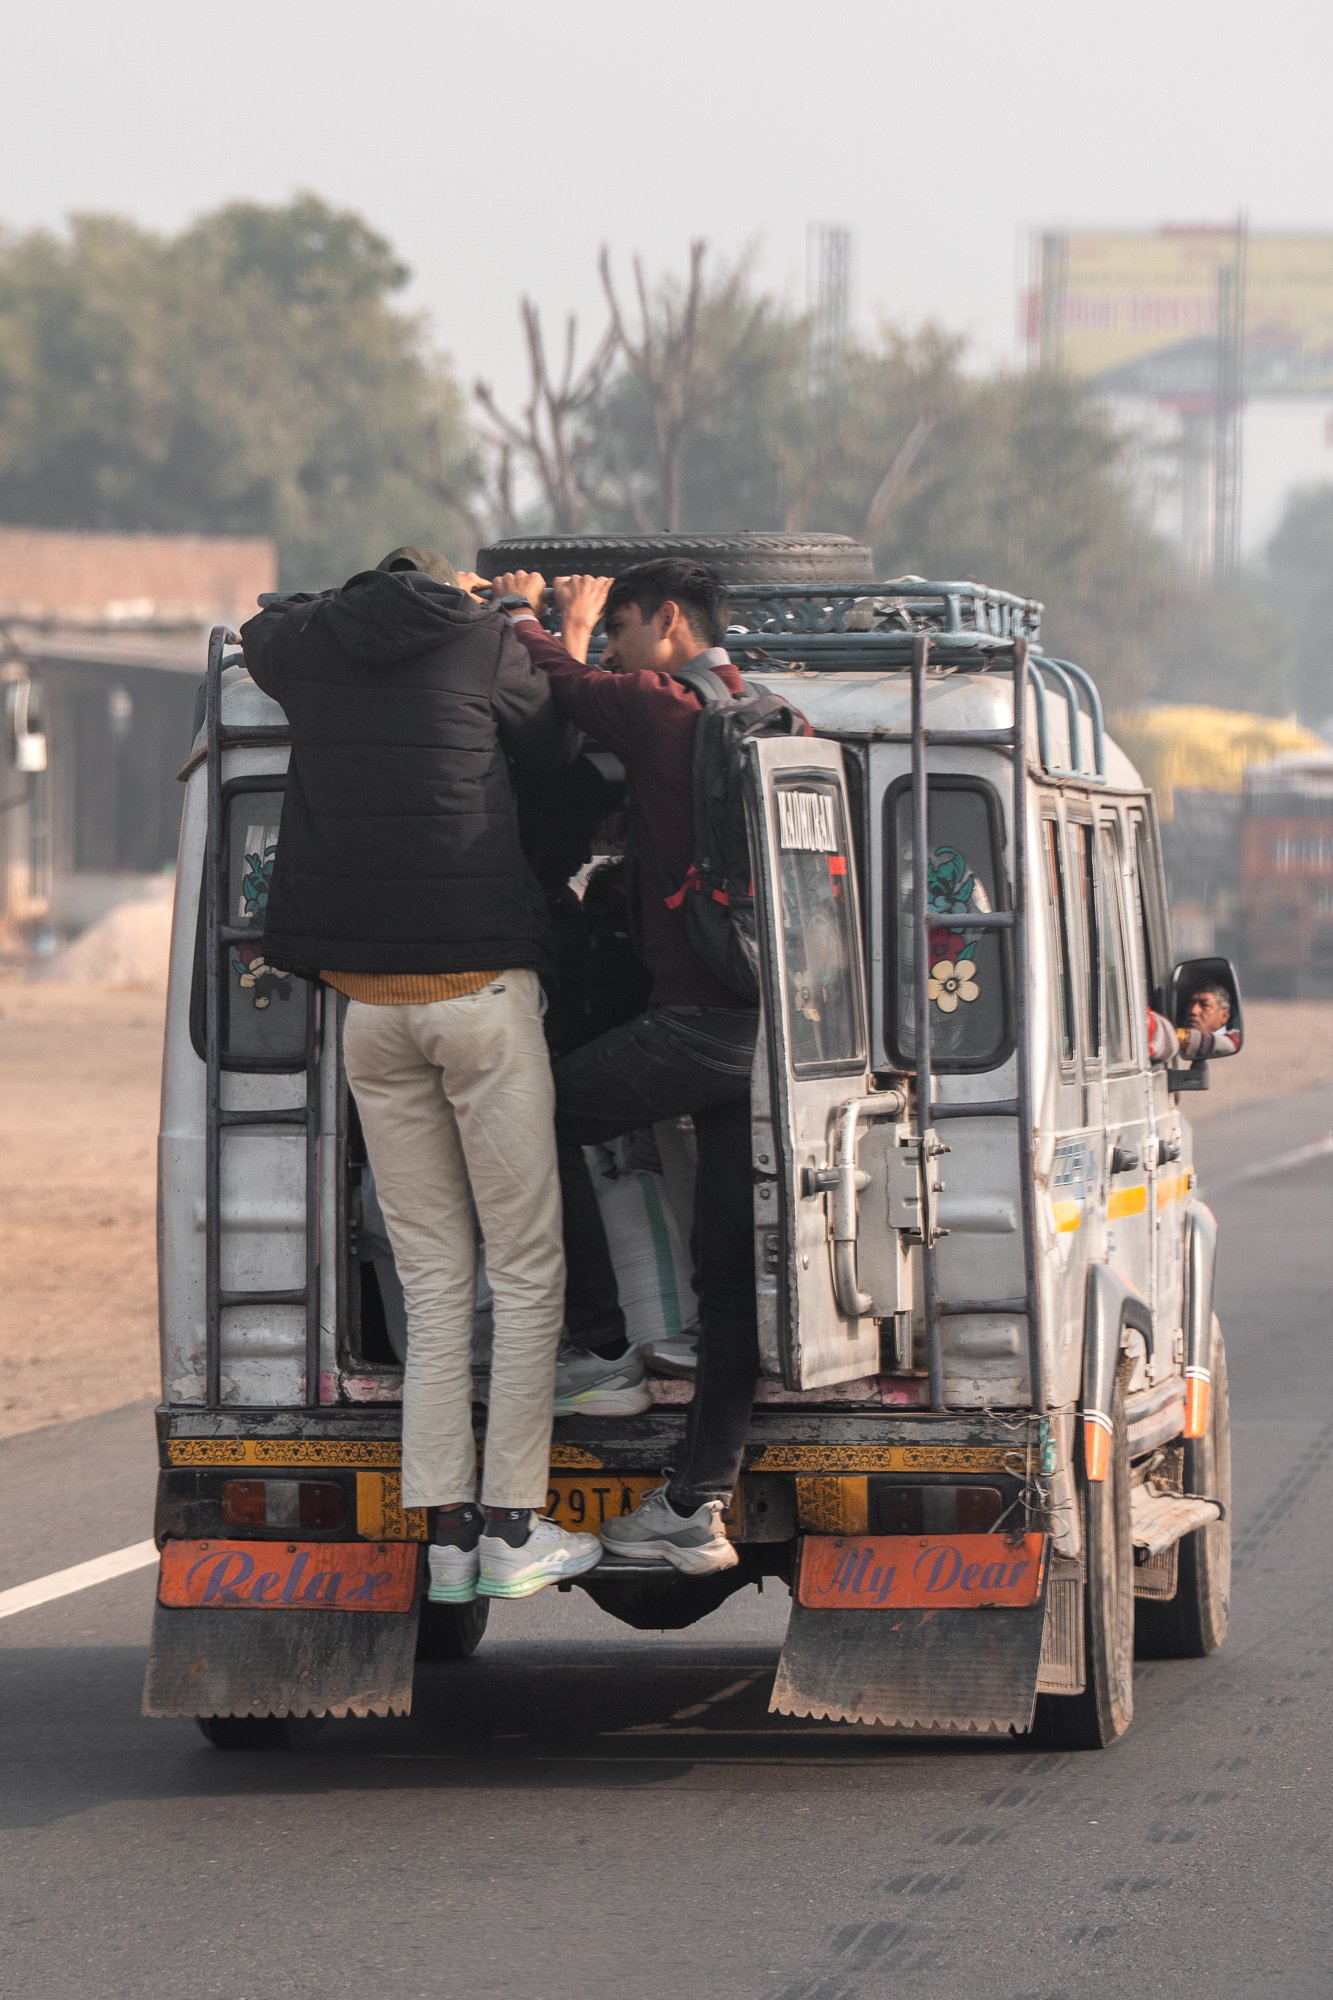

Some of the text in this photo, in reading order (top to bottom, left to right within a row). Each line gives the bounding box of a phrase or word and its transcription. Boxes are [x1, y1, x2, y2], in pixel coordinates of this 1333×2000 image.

[185, 1551, 393, 1603] Relax
[817, 1545, 1030, 1604] My Dear
